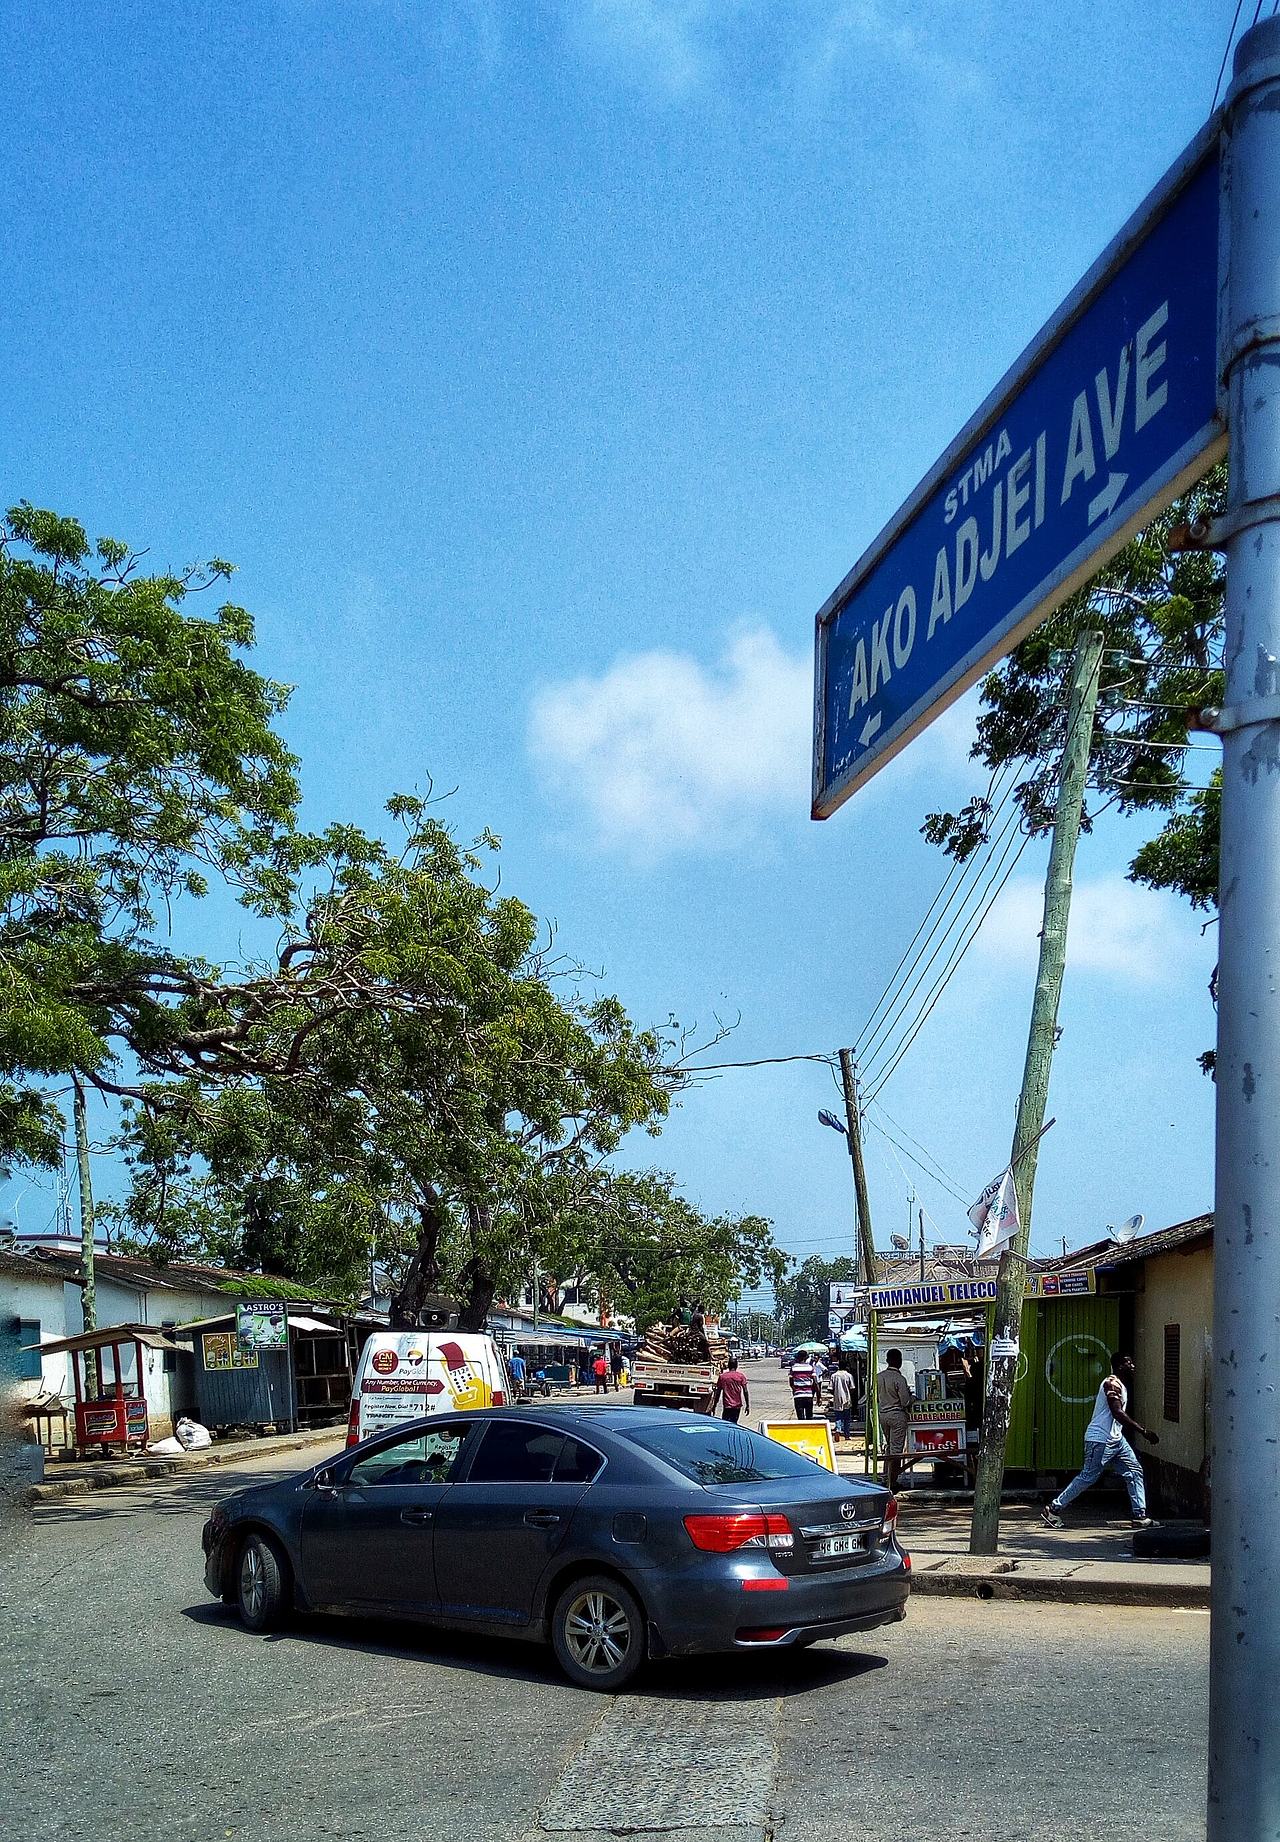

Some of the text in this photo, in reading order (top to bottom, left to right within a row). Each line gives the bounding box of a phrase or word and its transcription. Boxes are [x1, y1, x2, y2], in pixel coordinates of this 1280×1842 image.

[944, 428, 1012, 524] STMA
[848, 300, 1168, 719] AKO ADJEI AVE
[871, 1281, 997, 1307] EMMANUEL TELECO
[247, 1303, 284, 1311] ASTRO'S
[912, 1402, 964, 1412] ELECOM
[939, 1411, 961, 1420] HERE
